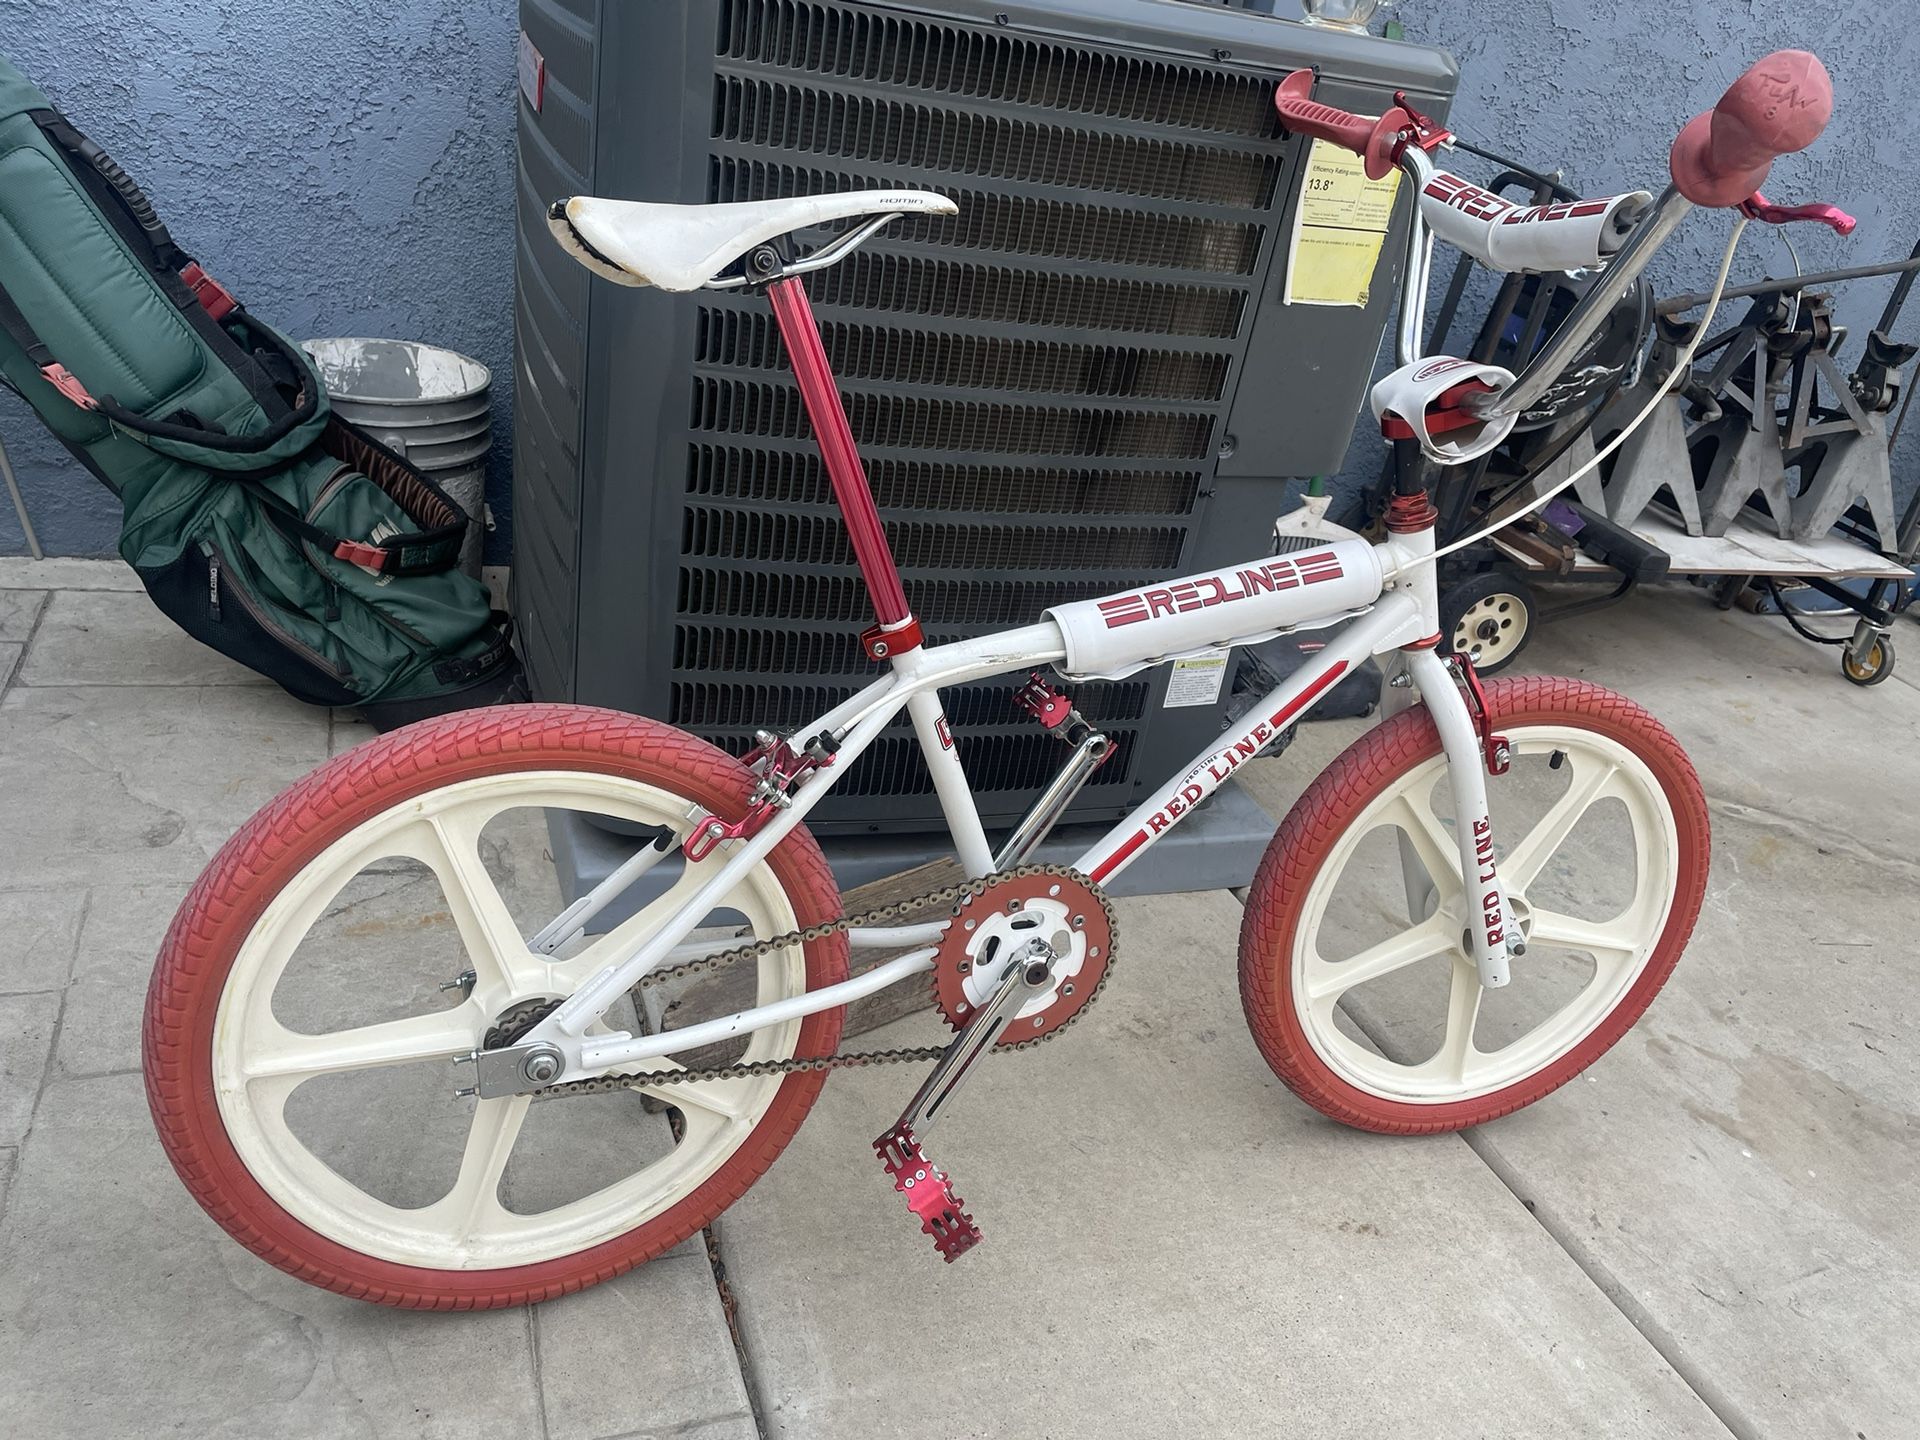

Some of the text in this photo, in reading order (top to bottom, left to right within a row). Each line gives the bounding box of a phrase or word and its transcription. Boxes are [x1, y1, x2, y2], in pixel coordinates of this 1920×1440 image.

[1312, 165, 1334, 174] Efficiency
[1334, 167, 1349, 176] Rating
[1143, 560, 1300, 619] REDLINE
[1146, 783, 1203, 835] RED
[1208, 722, 1272, 783] LINE
[1185, 754, 1218, 784] PRO-LINE
[1472, 815, 1505, 947] RED LINE
